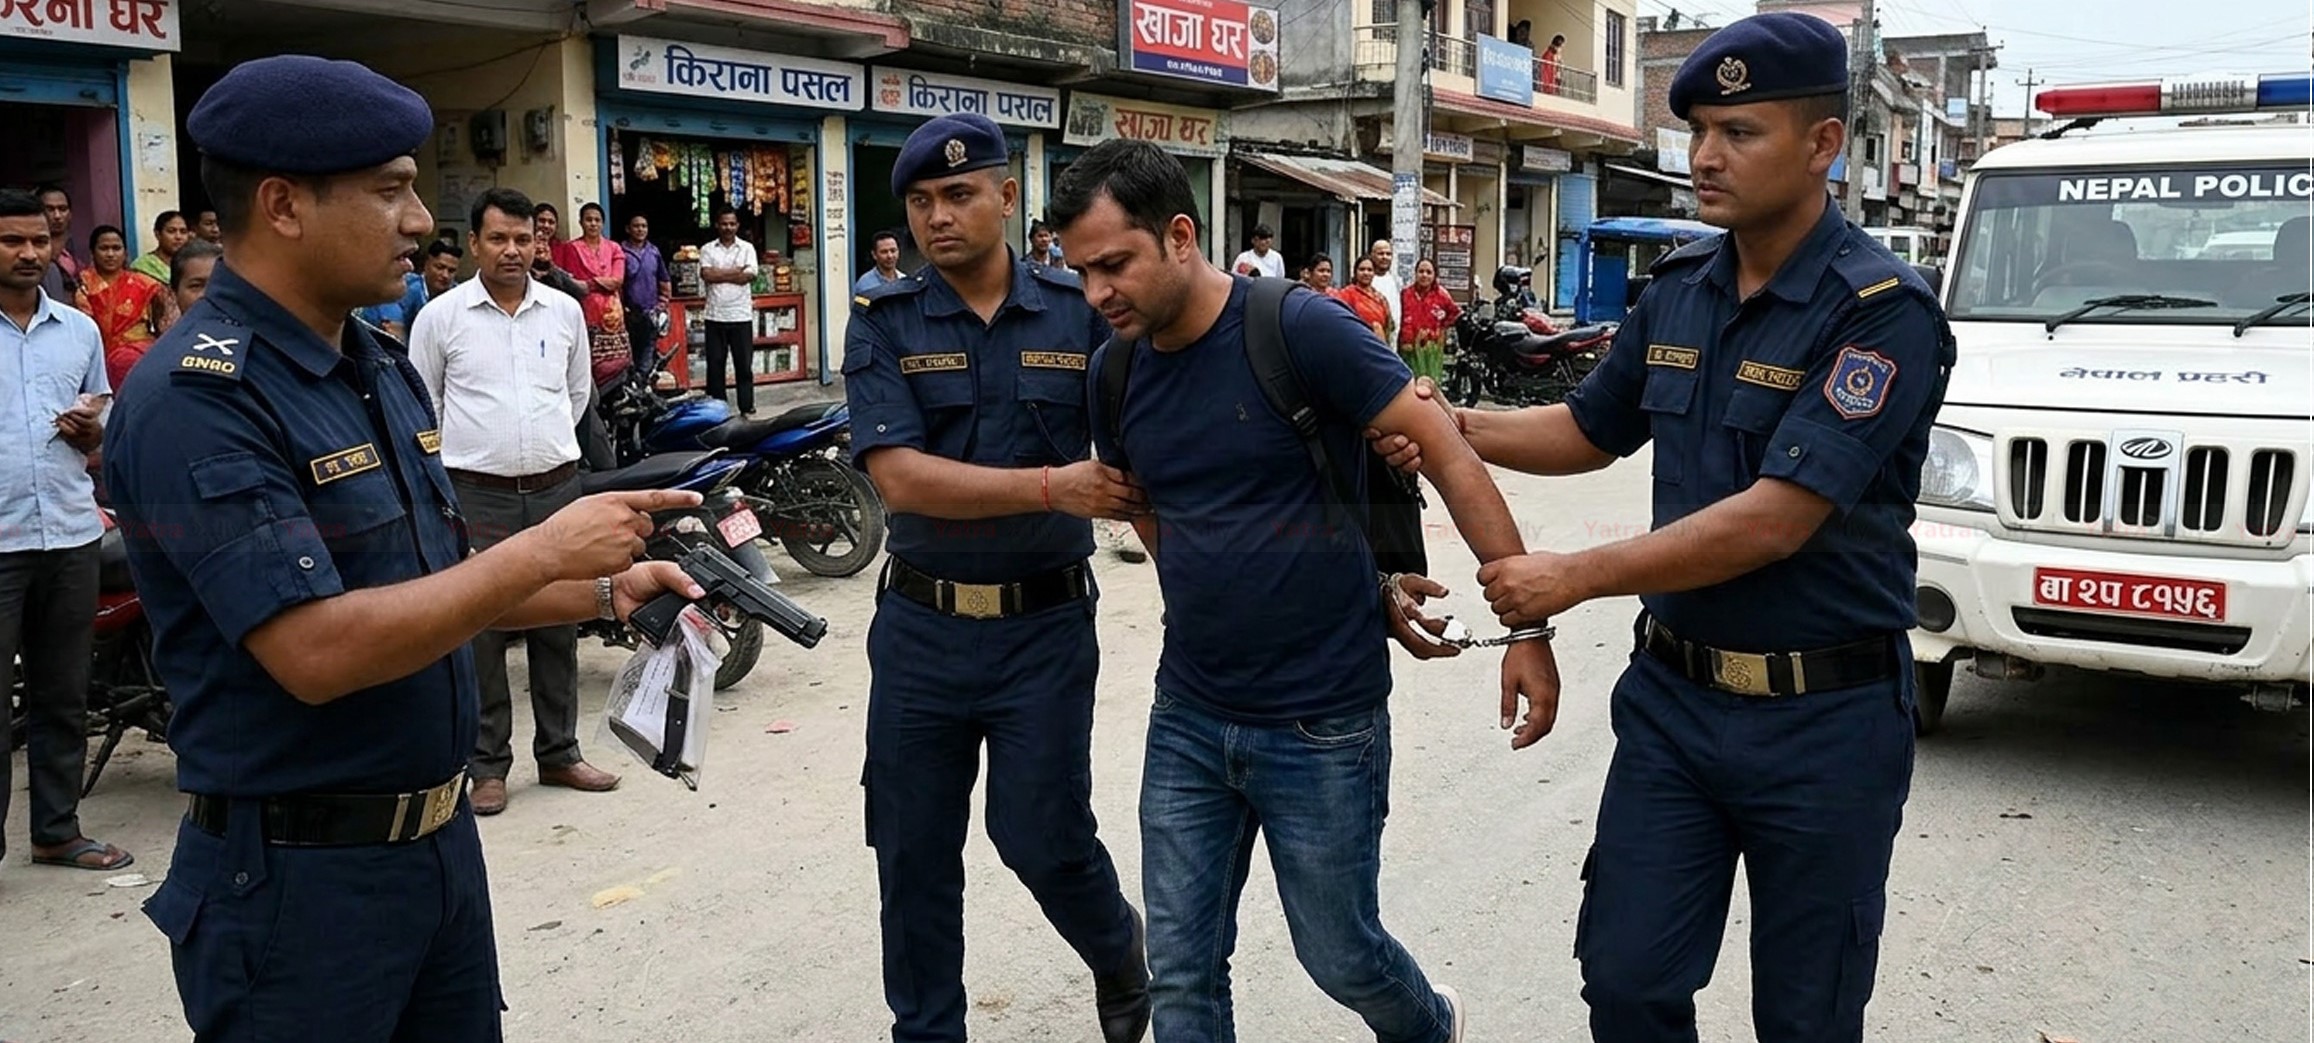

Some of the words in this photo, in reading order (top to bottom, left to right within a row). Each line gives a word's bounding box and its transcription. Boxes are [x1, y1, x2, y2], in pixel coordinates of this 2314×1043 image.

[1134, 2, 1204, 50] खाजा
[1210, 17, 1246, 60] घर
[664, 43, 771, 95] किराना
[781, 67, 852, 102] पसल
[908, 74, 989, 115] किराना
[2058, 176, 2181, 201] NEPAL
[2039, 575, 2073, 603] बा
[2131, 583, 2217, 619] ८१५६
